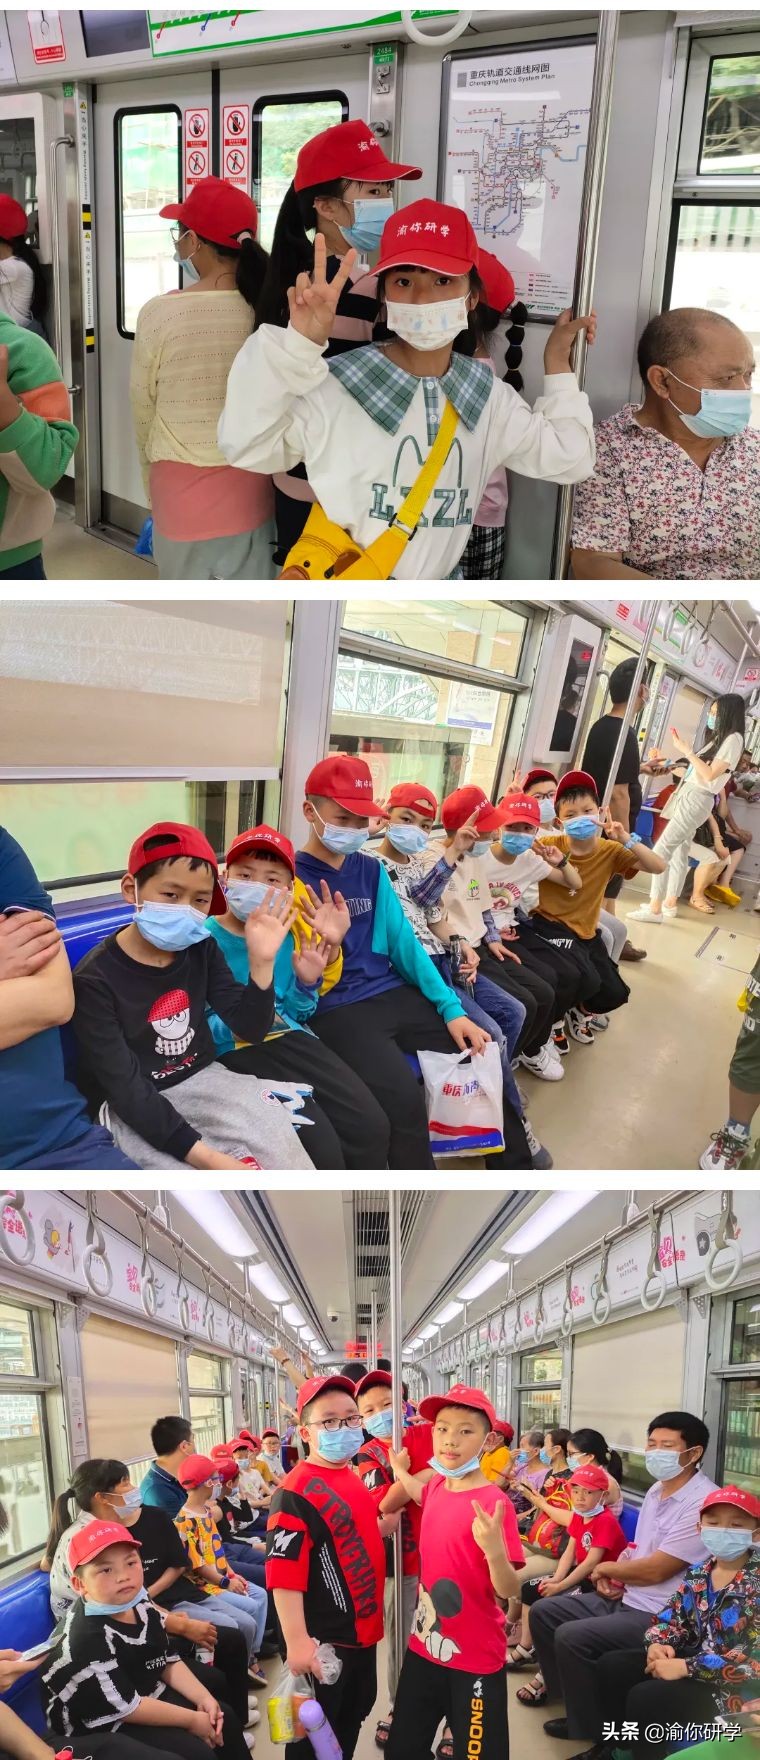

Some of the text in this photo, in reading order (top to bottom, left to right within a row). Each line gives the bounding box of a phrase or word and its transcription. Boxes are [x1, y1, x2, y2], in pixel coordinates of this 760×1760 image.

[469, 62, 550, 80] 重庆轨道交通线网图
[468, 78, 499, 87] Chongqing
[500, 76, 517, 84] Metro
[518, 74, 540, 83] System
[396, 221, 450, 238] 渝你研学
